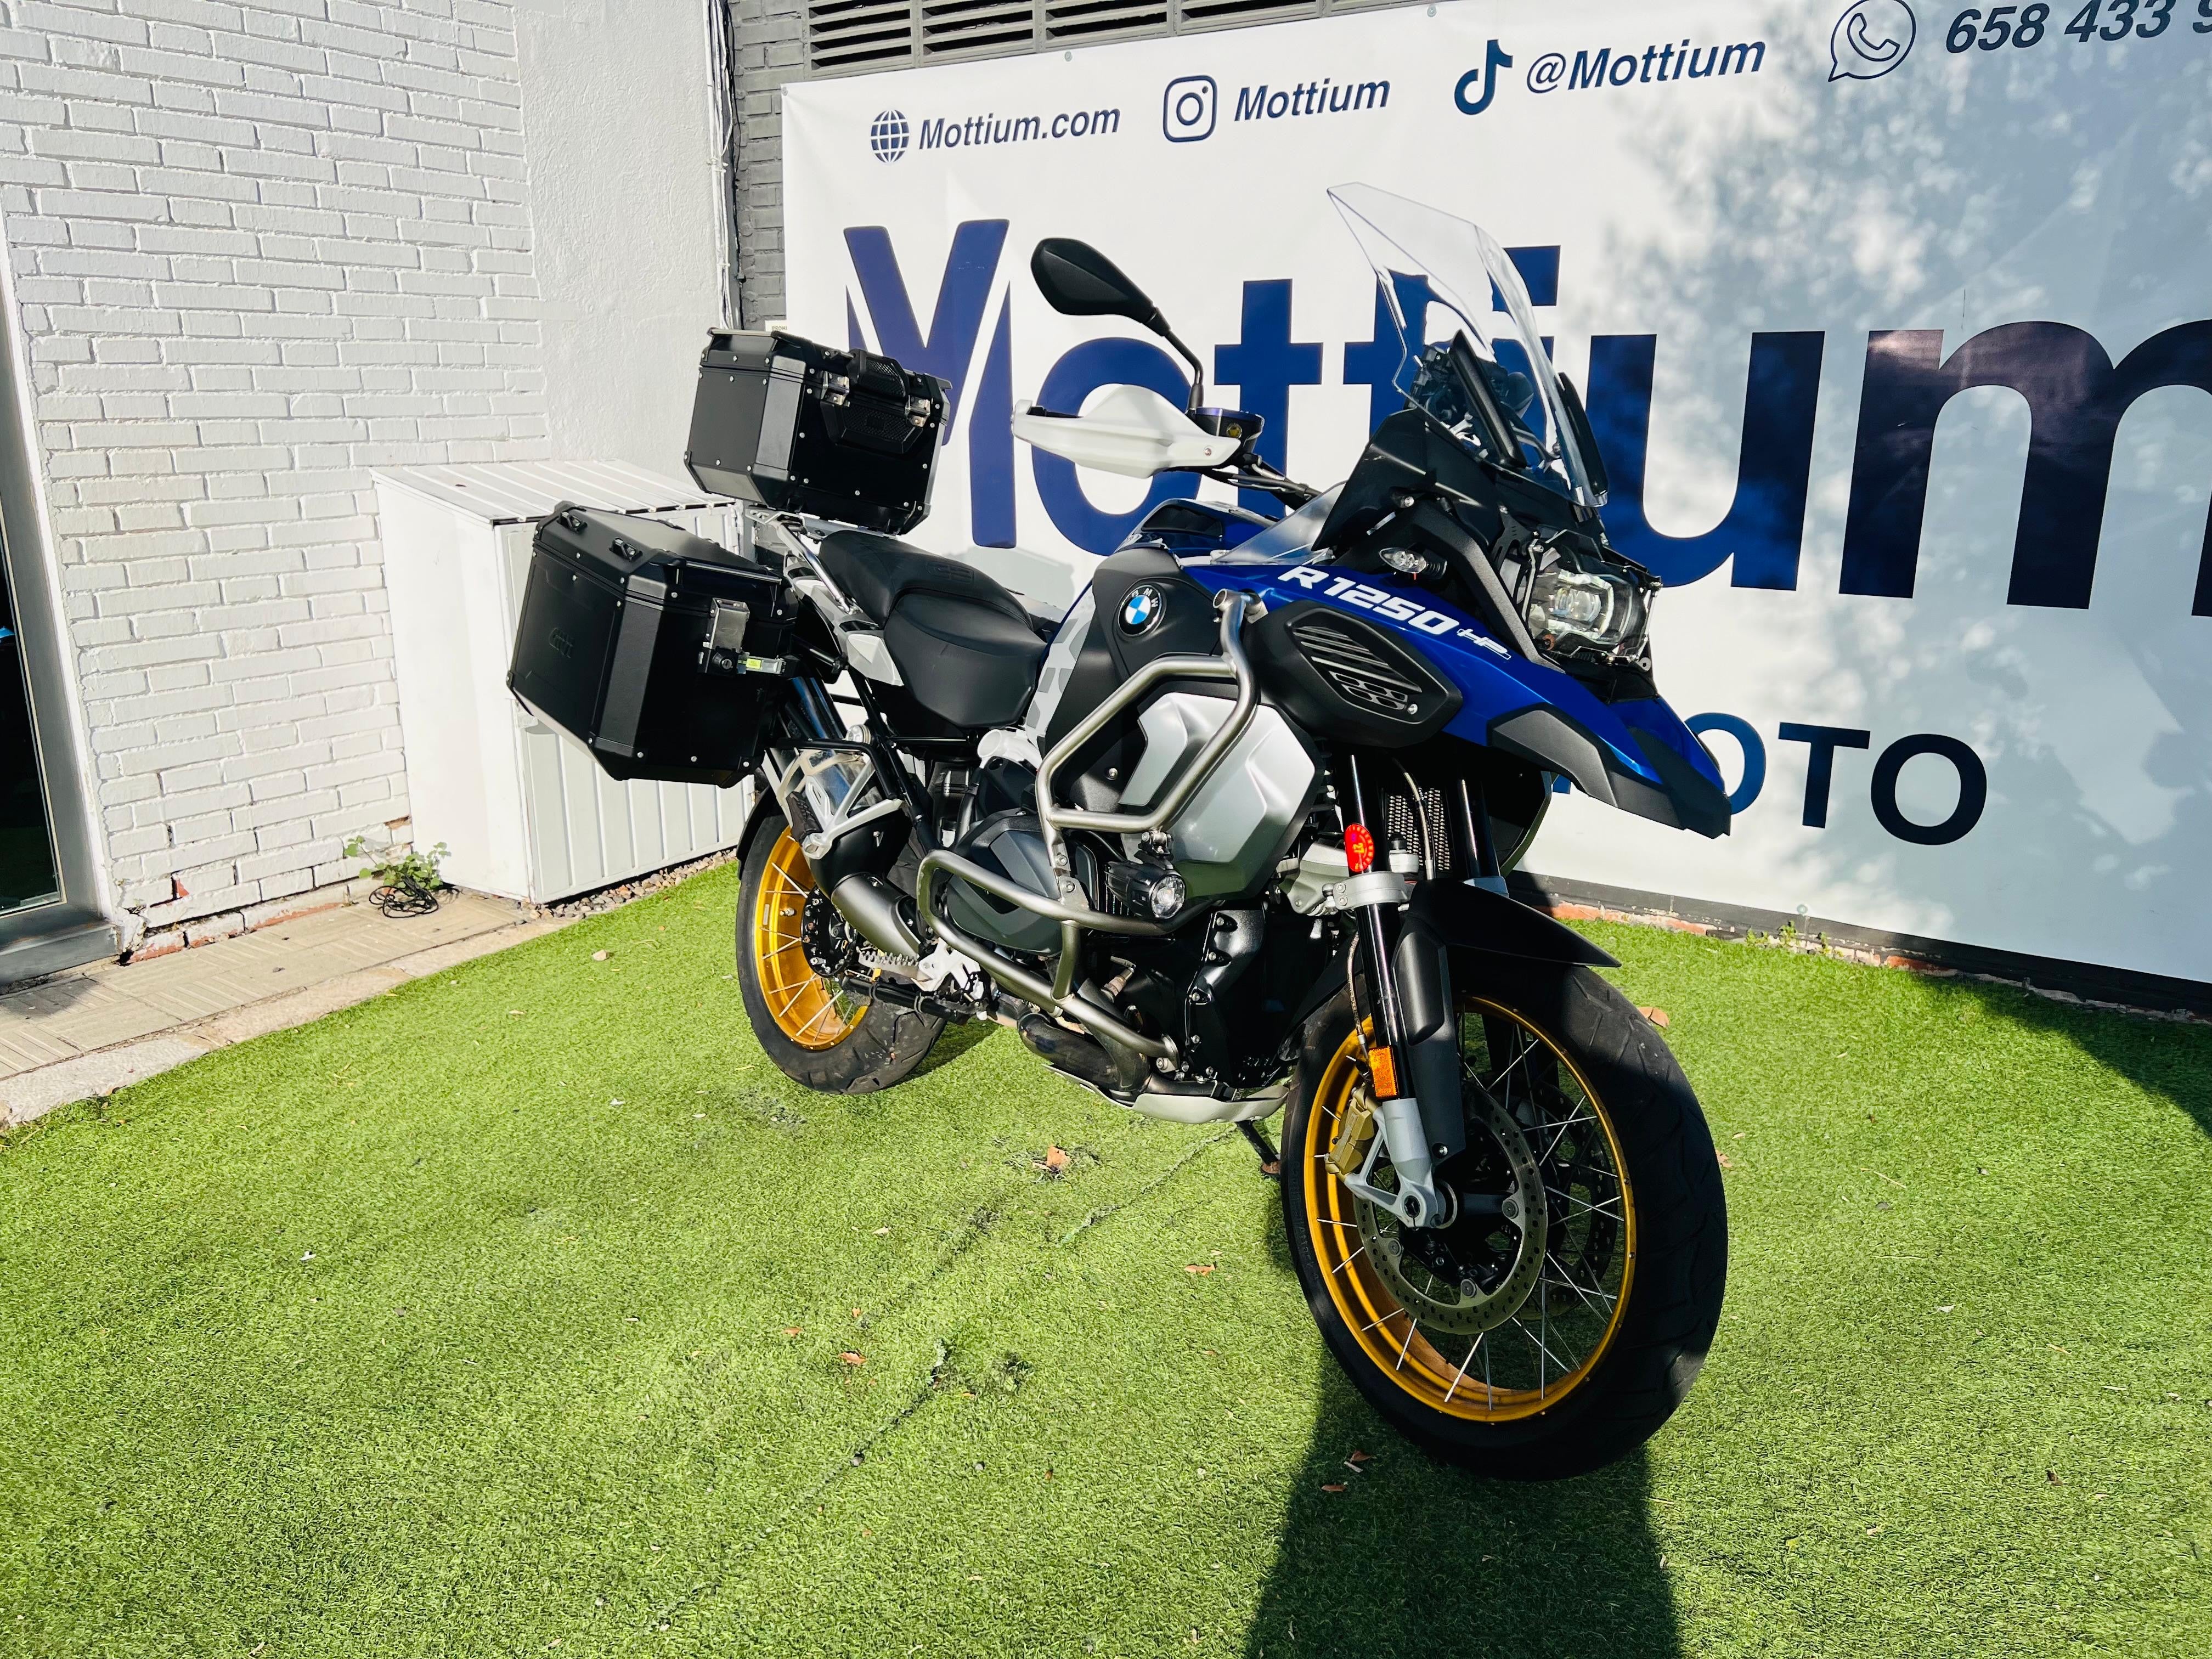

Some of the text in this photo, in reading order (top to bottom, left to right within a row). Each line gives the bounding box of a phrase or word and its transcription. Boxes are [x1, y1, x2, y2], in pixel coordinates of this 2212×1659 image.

[1946, 3, 2050, 54] 658
[2064, 0, 2176, 43] 433
[1527, 38, 1765, 94] @Mottium
[1234, 78, 1390, 121] Mottium
[919, 109, 1120, 150] Mottium.com
[844, 219, 2212, 617] Mottium
[1278, 566, 1329, 589] R
[1324, 576, 1460, 635] 1250
[1551, 712, 1987, 845] OTO
